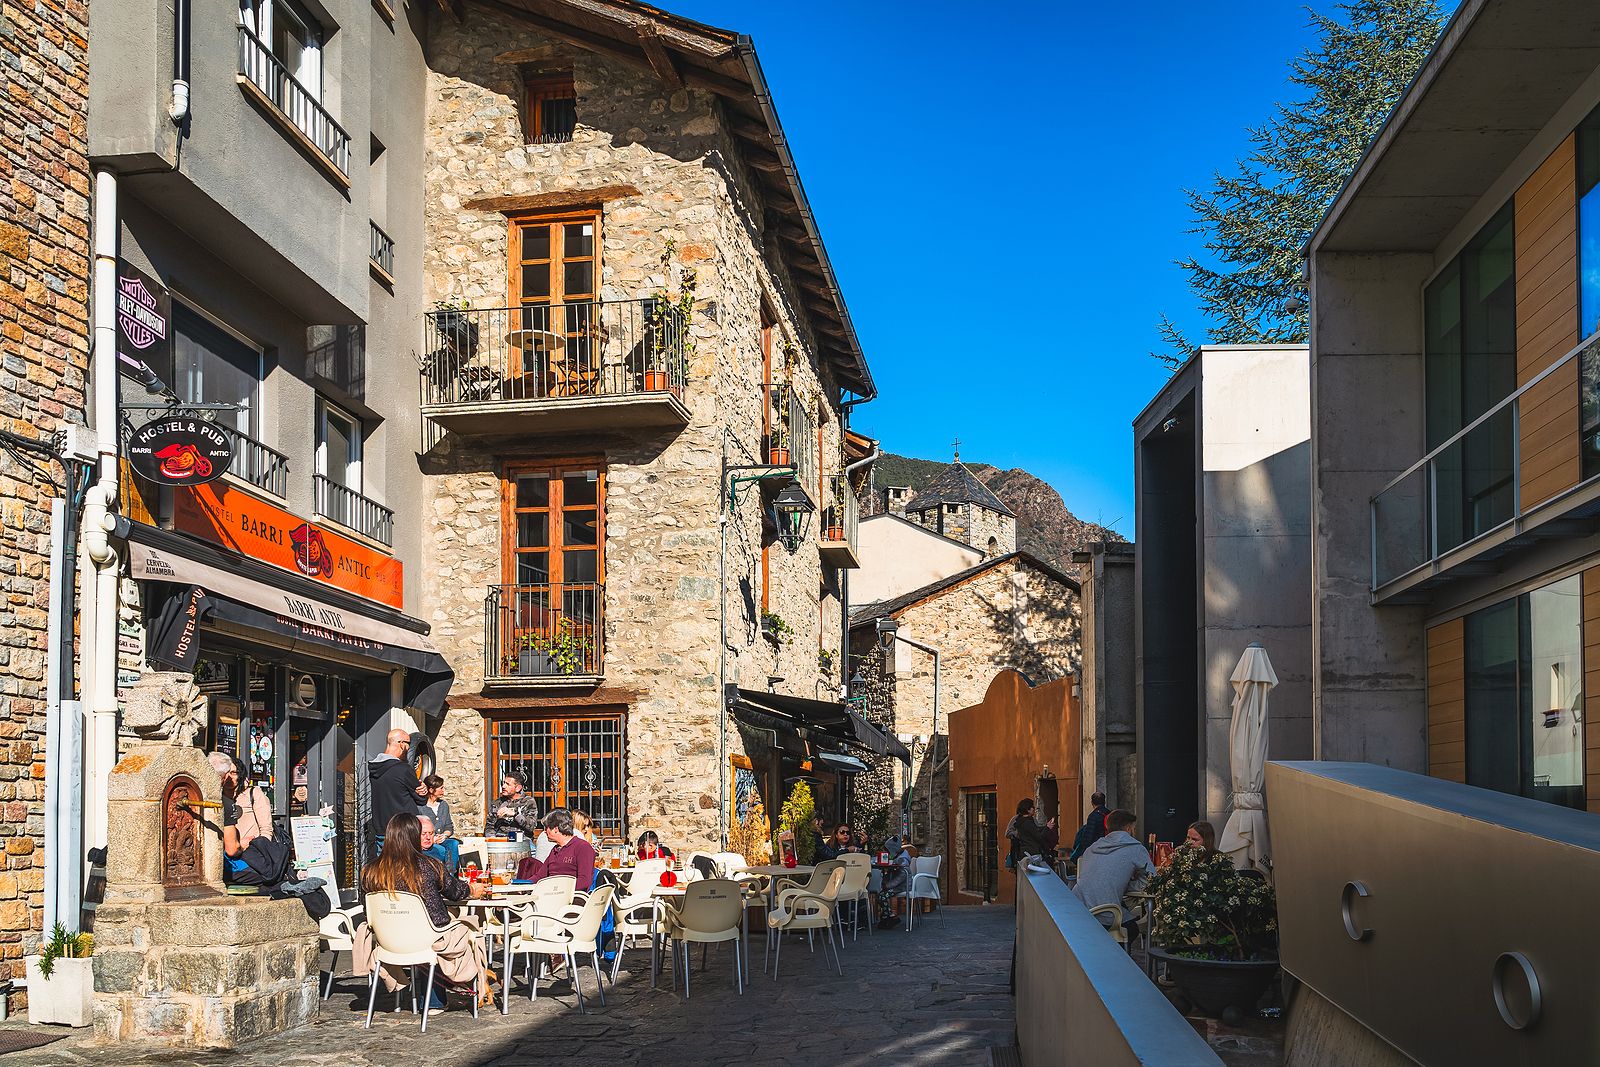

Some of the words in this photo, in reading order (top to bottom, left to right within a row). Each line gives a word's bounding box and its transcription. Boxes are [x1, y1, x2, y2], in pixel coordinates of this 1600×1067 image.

[124, 282, 154, 309] MOTOR
[119, 294, 163, 335] RLEY-DAVIDSON
[123, 316, 152, 345] CYCLES
[138, 421, 185, 443] HOSTEL
[187, 422, 196, 433] &
[200, 426, 225, 446] PUB
[241, 513, 284, 546] BARRI
[337, 555, 371, 580] ANTIC
[145, 566, 176, 577] ALHAMBRA
[283, 595, 317, 622] BARRI
[318, 607, 346, 630] ANTIC
[174, 618, 196, 659] HOSTEL
[301, 623, 335, 641] BARRI
[337, 632, 370, 649] ANTIC
